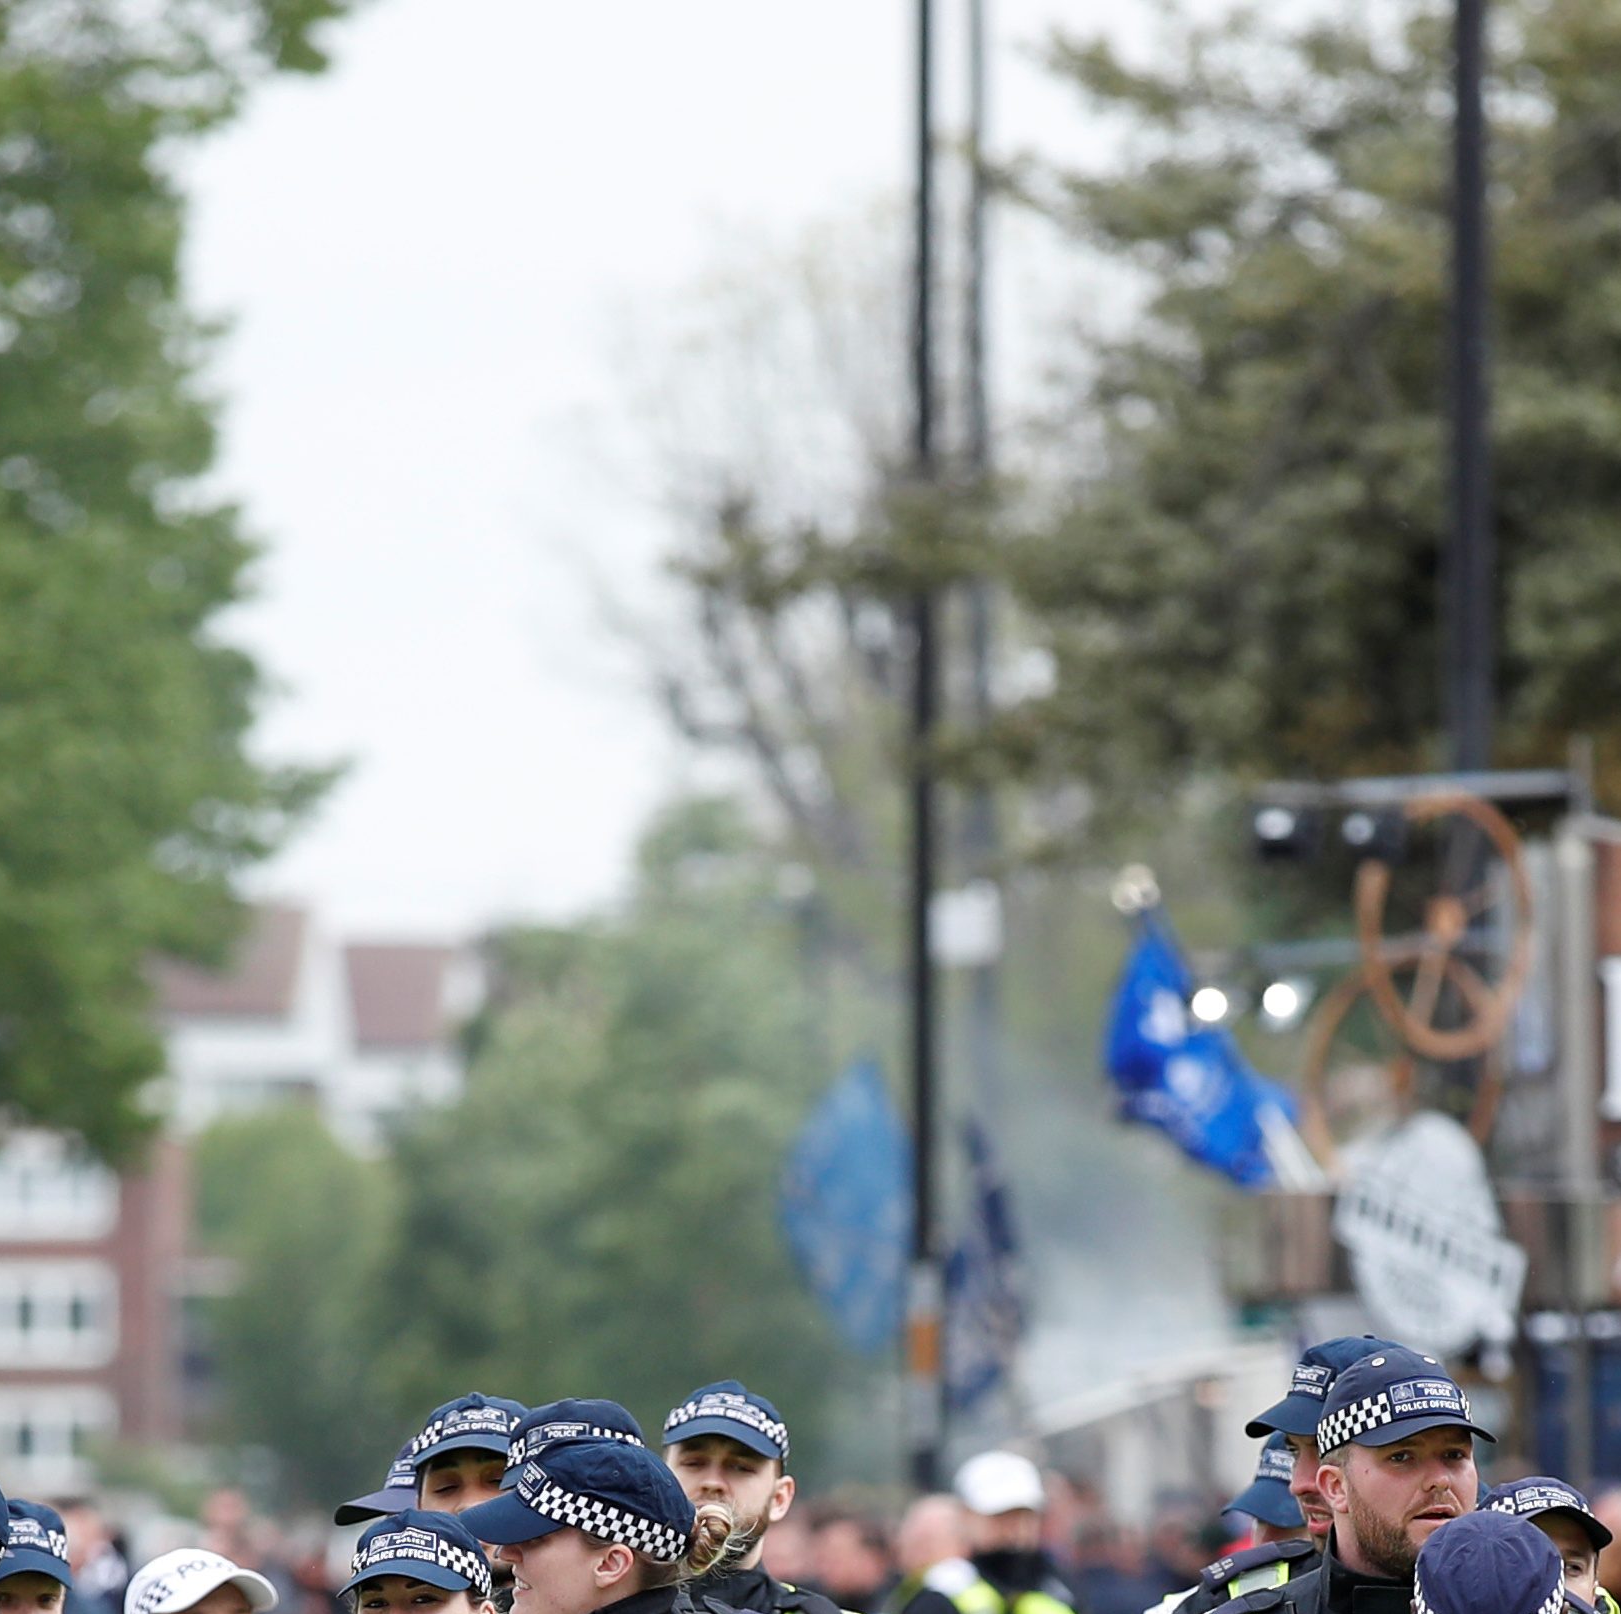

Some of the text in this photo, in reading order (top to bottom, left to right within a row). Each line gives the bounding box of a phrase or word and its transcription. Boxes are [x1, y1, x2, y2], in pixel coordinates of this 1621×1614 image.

[1424, 1387, 1451, 1397] POLICE
[1394, 1400, 1461, 1413] POLICE OFFICER
[442, 1422, 508, 1436] POLICE OFFICER
[547, 1430, 577, 1438] POLICE
[366, 1548, 436, 1566] POLICE OFFICER
